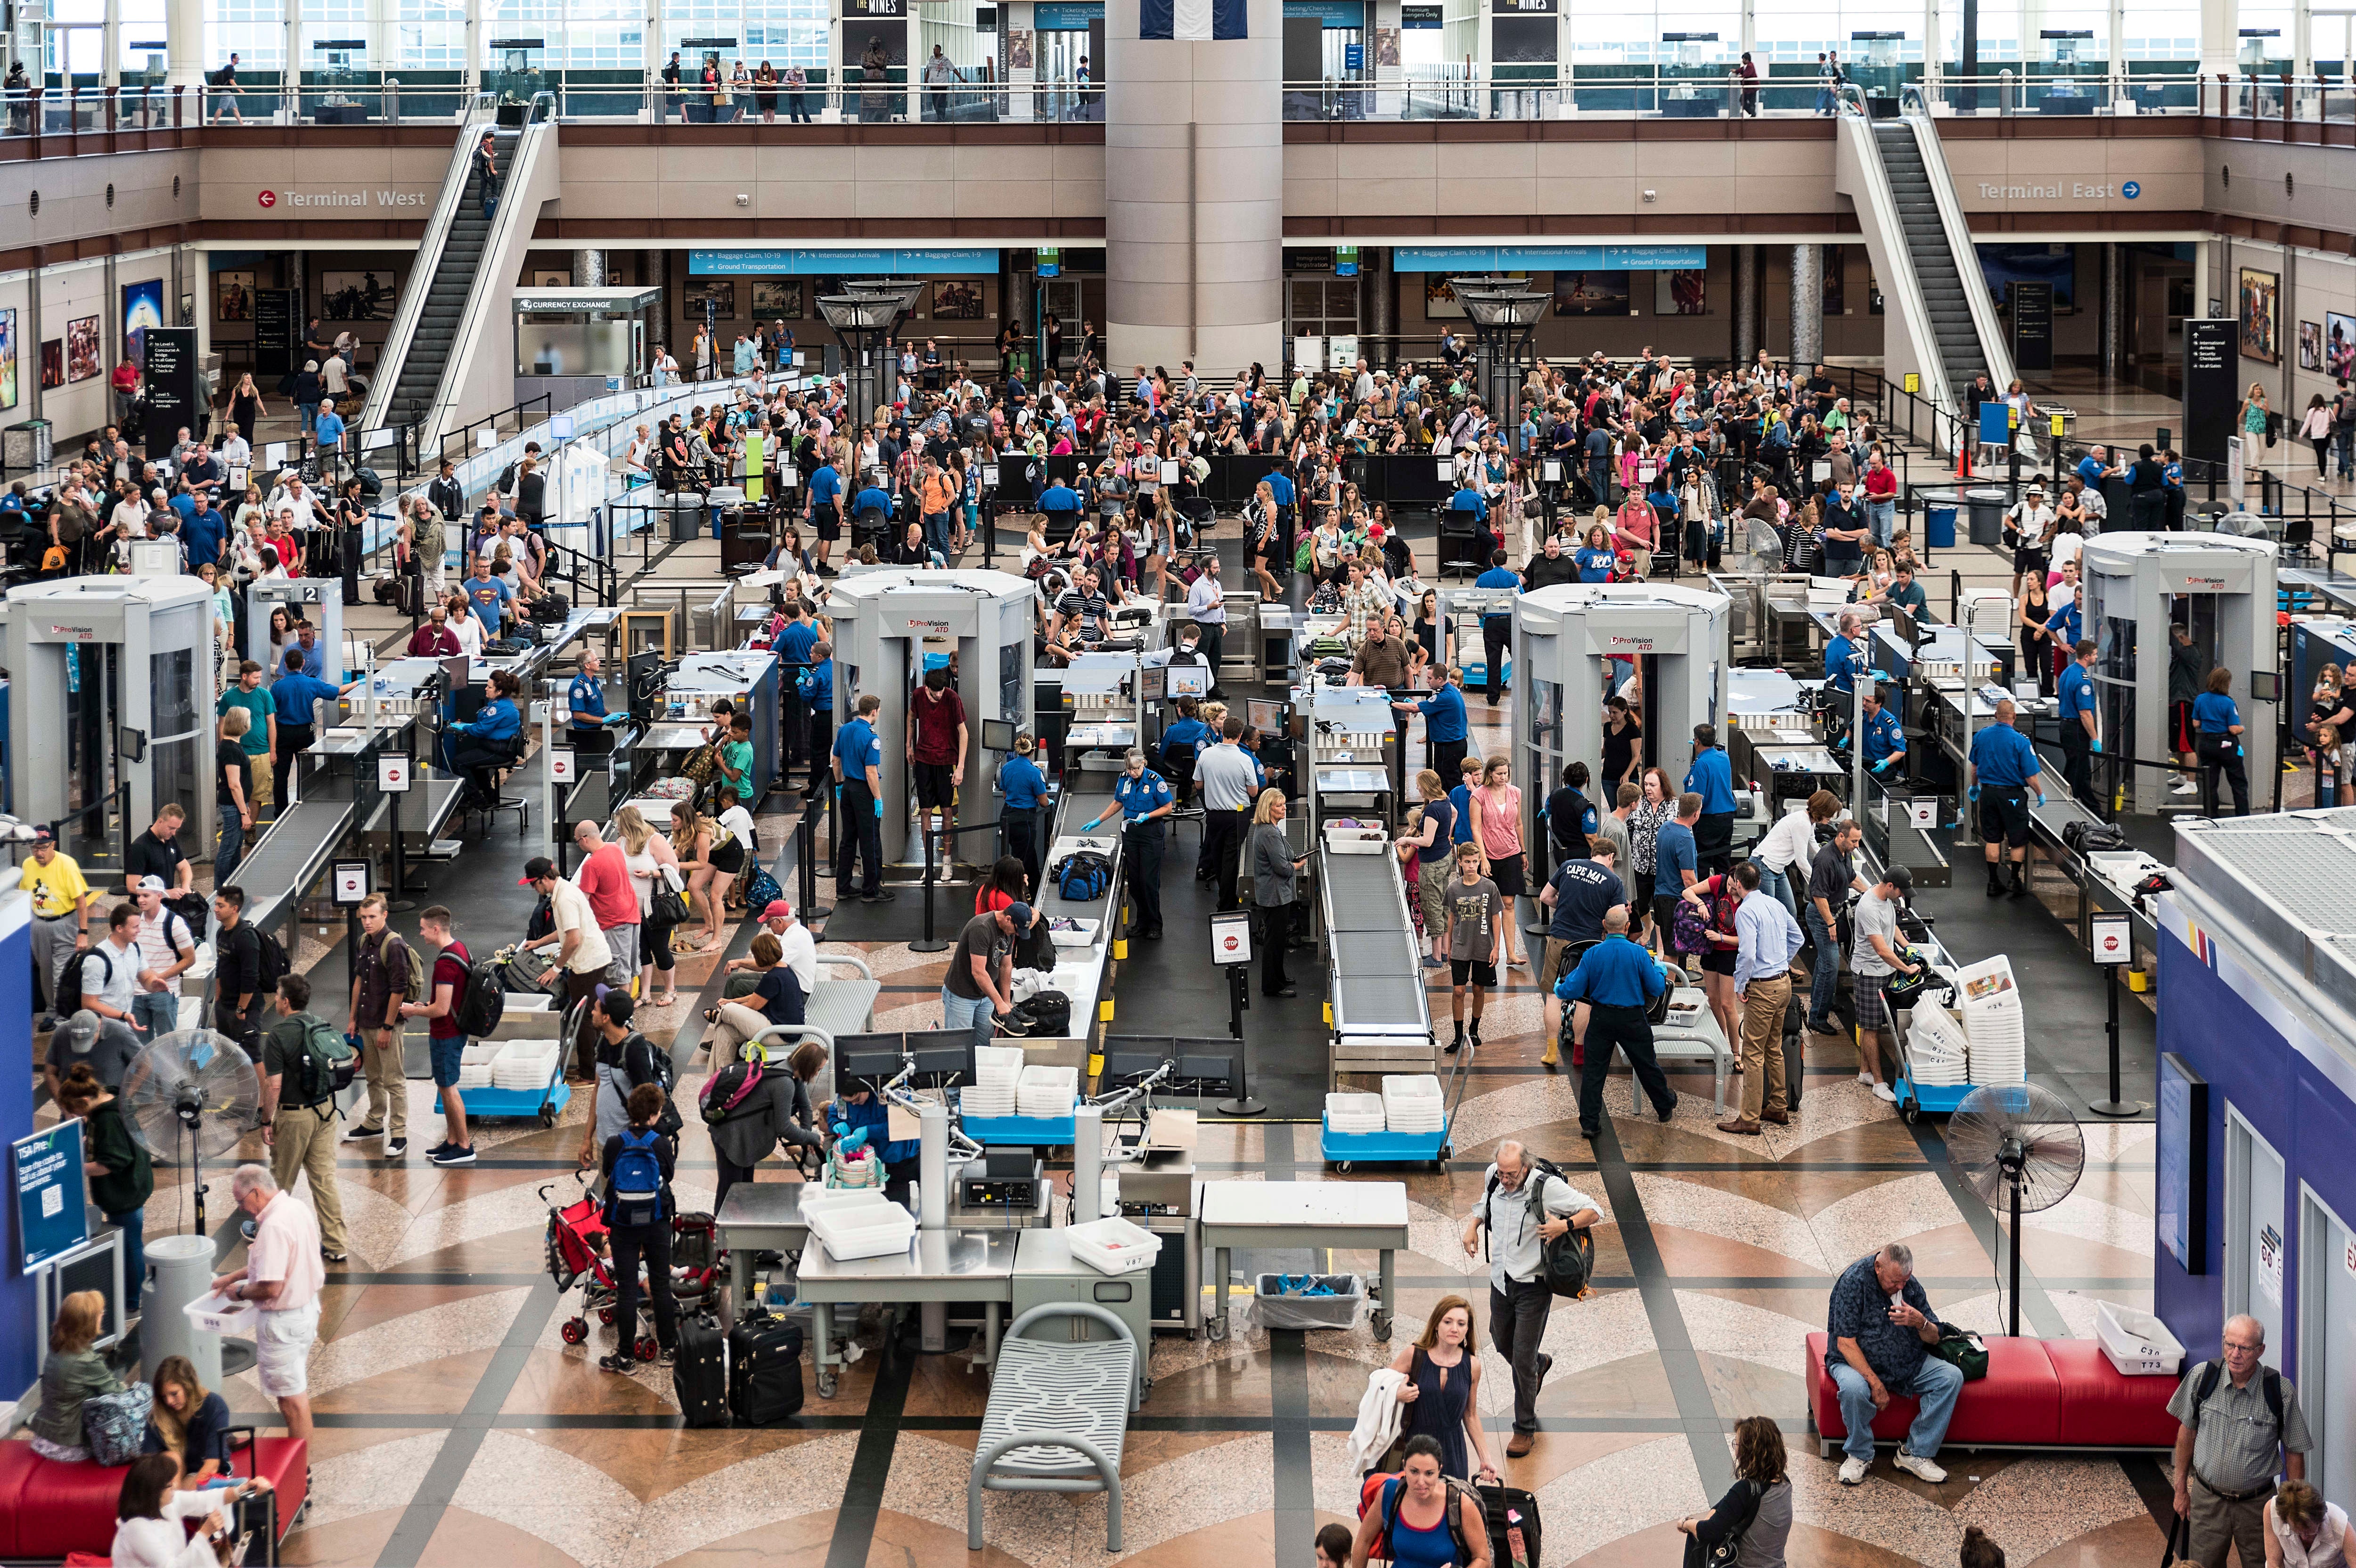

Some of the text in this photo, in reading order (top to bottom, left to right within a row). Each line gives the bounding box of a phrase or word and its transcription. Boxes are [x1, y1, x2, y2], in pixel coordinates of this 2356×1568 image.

[868, 0, 896, 13] MINES
[1978, 181, 2114, 199] Terminal East
[284, 190, 426, 206] Terminal West
[306, 588, 316, 601] 2
[1969, 628, 1972, 636] 8
[367, 664, 370, 672] 3
[1137, 659, 1140, 667] 5
[1857, 679, 1862, 688] 7
[1309, 699, 1314, 708] 6
[543, 706, 547, 715] 4
[1567, 865, 1607, 885] CAPE MAY
[1581, 877, 1595, 885] JERSEY
[1481, 893, 1489, 935] COLORADO
[17, 1141, 48, 1160] TSA Pre
